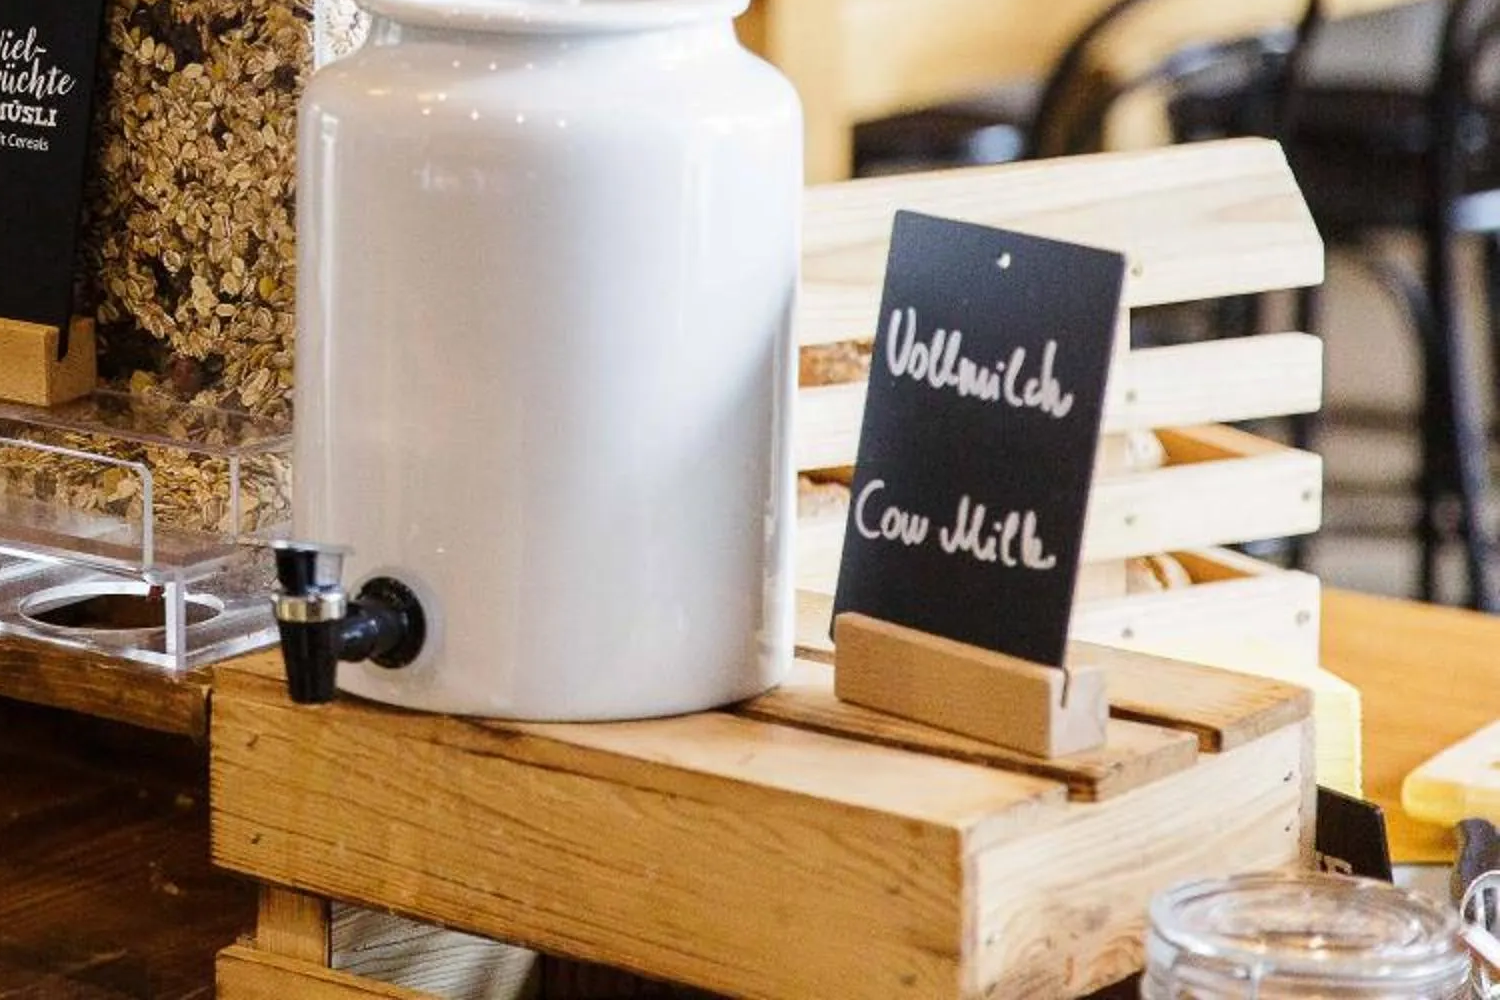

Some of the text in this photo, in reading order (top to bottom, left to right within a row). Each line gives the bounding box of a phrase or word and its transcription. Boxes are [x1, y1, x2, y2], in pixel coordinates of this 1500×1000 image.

[7, 133, 49, 151] Cereals
[887, 307, 1074, 418] Vollmilch
[855, 479, 1056, 570] Cow Milk
